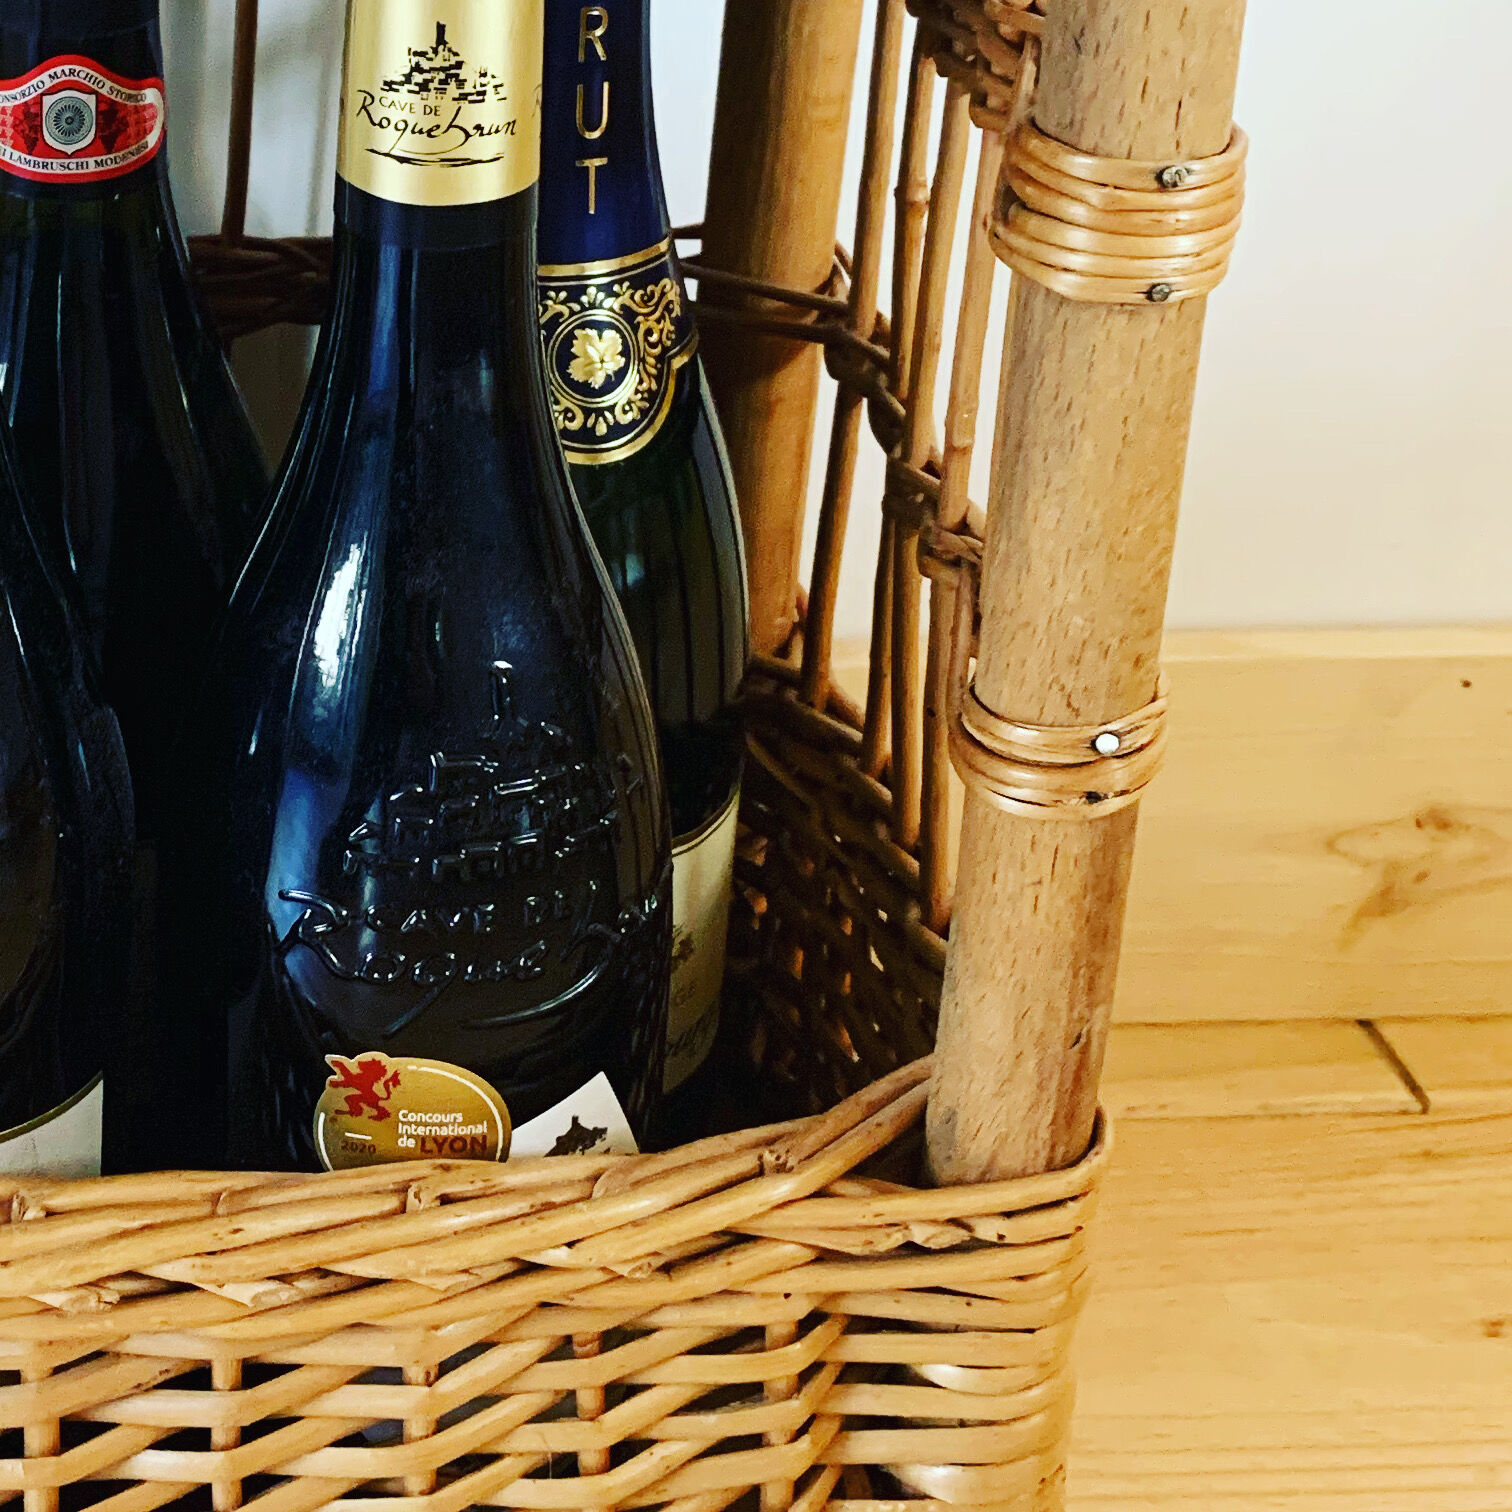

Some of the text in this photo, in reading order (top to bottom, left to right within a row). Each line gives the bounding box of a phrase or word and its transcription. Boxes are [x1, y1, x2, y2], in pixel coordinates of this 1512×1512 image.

[48, 67, 106, 90] MARCHIO
[106, 84, 147, 103] STORICO
[379, 96, 441, 117] CAVE DE
[356, 89, 517, 155] Roquebrun
[9, 153, 89, 171] LAMBRUSCHI
[94, 140, 149, 169] MODENESI
[398, 1110, 463, 1123] Concours
[398, 1120, 488, 1136] International
[340, 1140, 377, 1154] 2020
[397, 1134, 488, 1154] de LYON
